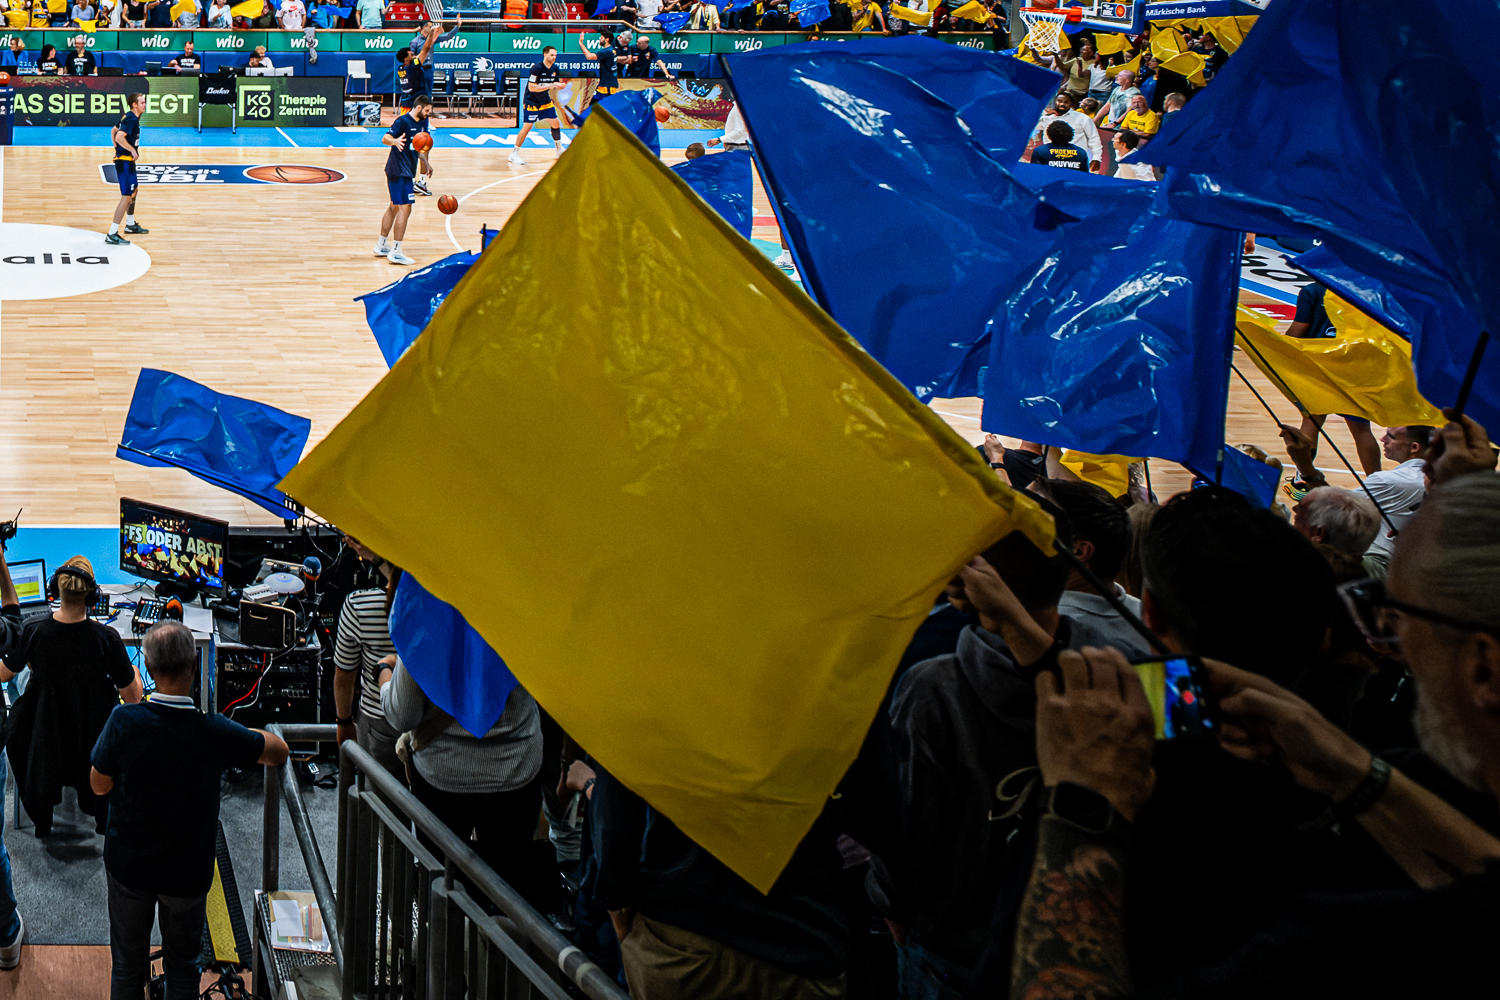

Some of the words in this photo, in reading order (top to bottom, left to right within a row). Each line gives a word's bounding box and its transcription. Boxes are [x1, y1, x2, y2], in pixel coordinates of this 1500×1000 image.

[1146, 7, 1185, 17] Märkische
[1187, 5, 1206, 14] Bank
[141, 36, 170, 48] wilo
[216, 36, 244, 49] wilo
[365, 36, 393, 49] wilo
[513, 36, 541, 49] wilo
[660, 36, 689, 50] wilo
[734, 37, 763, 51] wilo
[49, 93, 85, 114] SIE
[247, 92, 271, 106] KÖ
[279, 94, 327, 107] Therapie
[247, 105, 271, 118] 40
[279, 105, 327, 116] Zentrum
[146, 529, 182, 551] ODER
